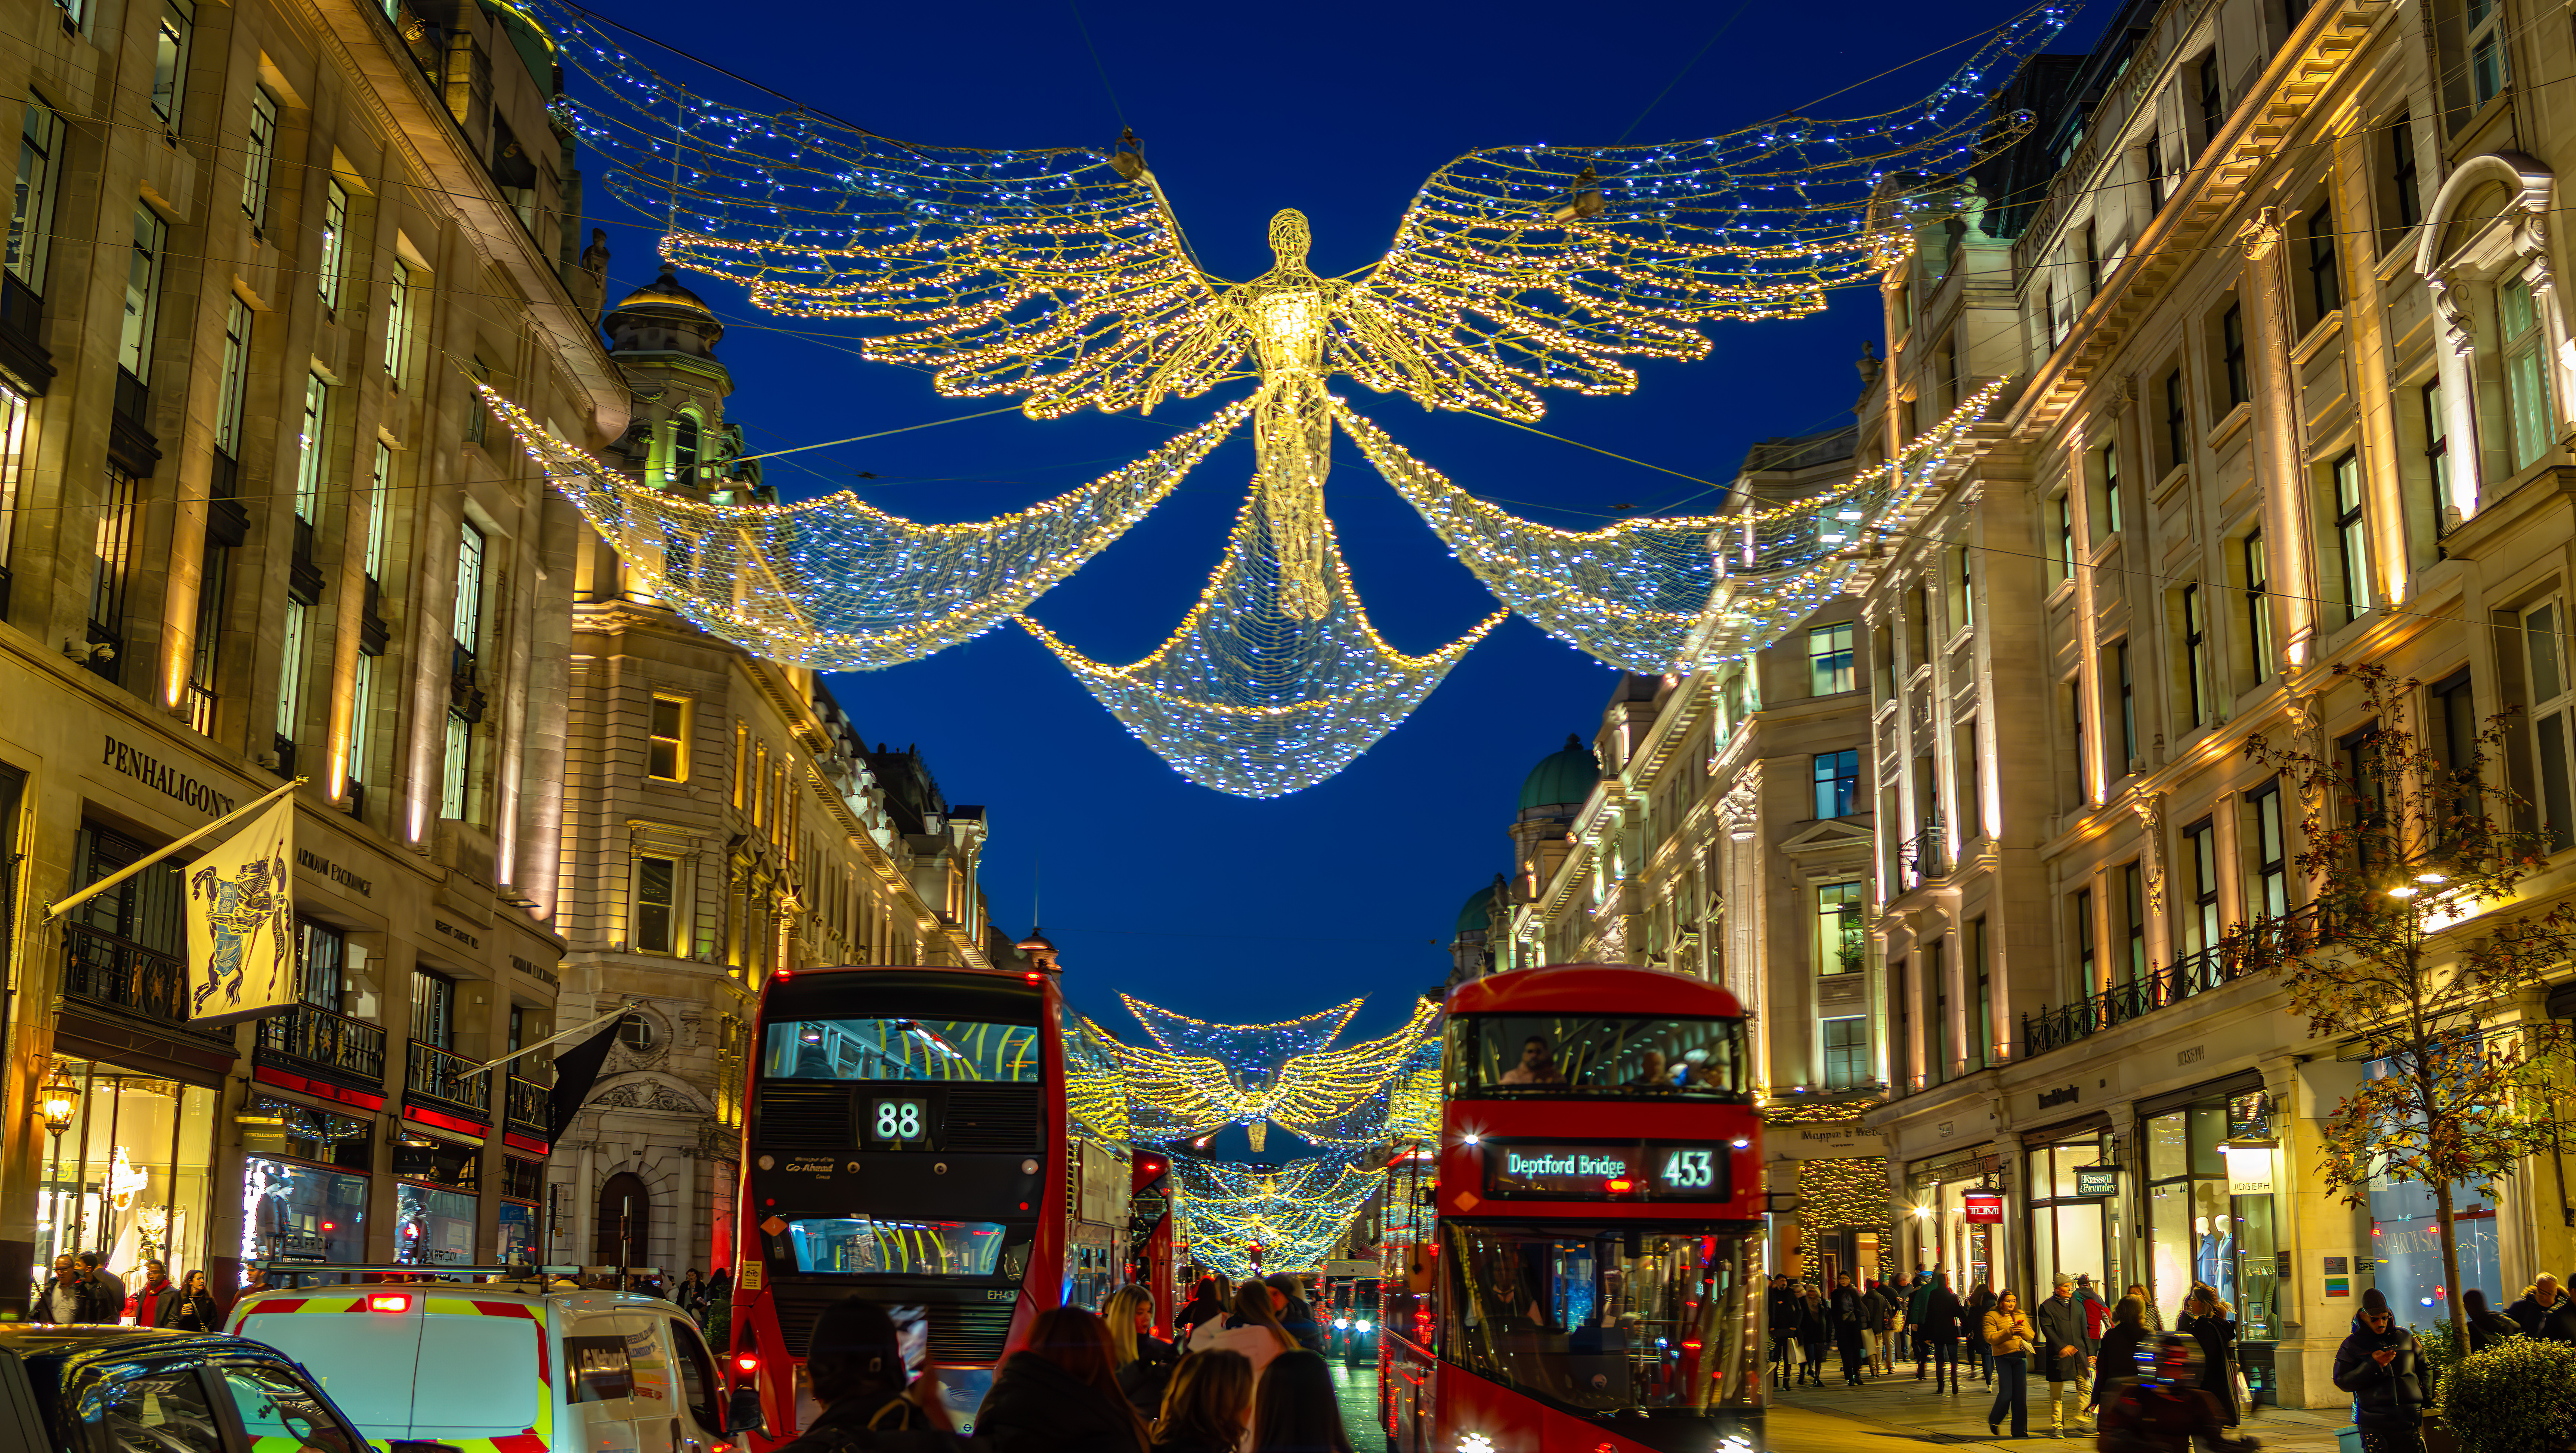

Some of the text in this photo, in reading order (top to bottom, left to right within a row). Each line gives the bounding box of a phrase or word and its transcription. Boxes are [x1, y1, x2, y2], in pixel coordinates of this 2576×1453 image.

[876, 1102, 920, 1139] 88
[1508, 1151, 1713, 1187] Deptford Bridge 453
[2081, 1174, 2112, 1184] Russell
[2232, 1182, 2270, 1191] JOSEPH
[1967, 1206, 1999, 1215] TUMI
